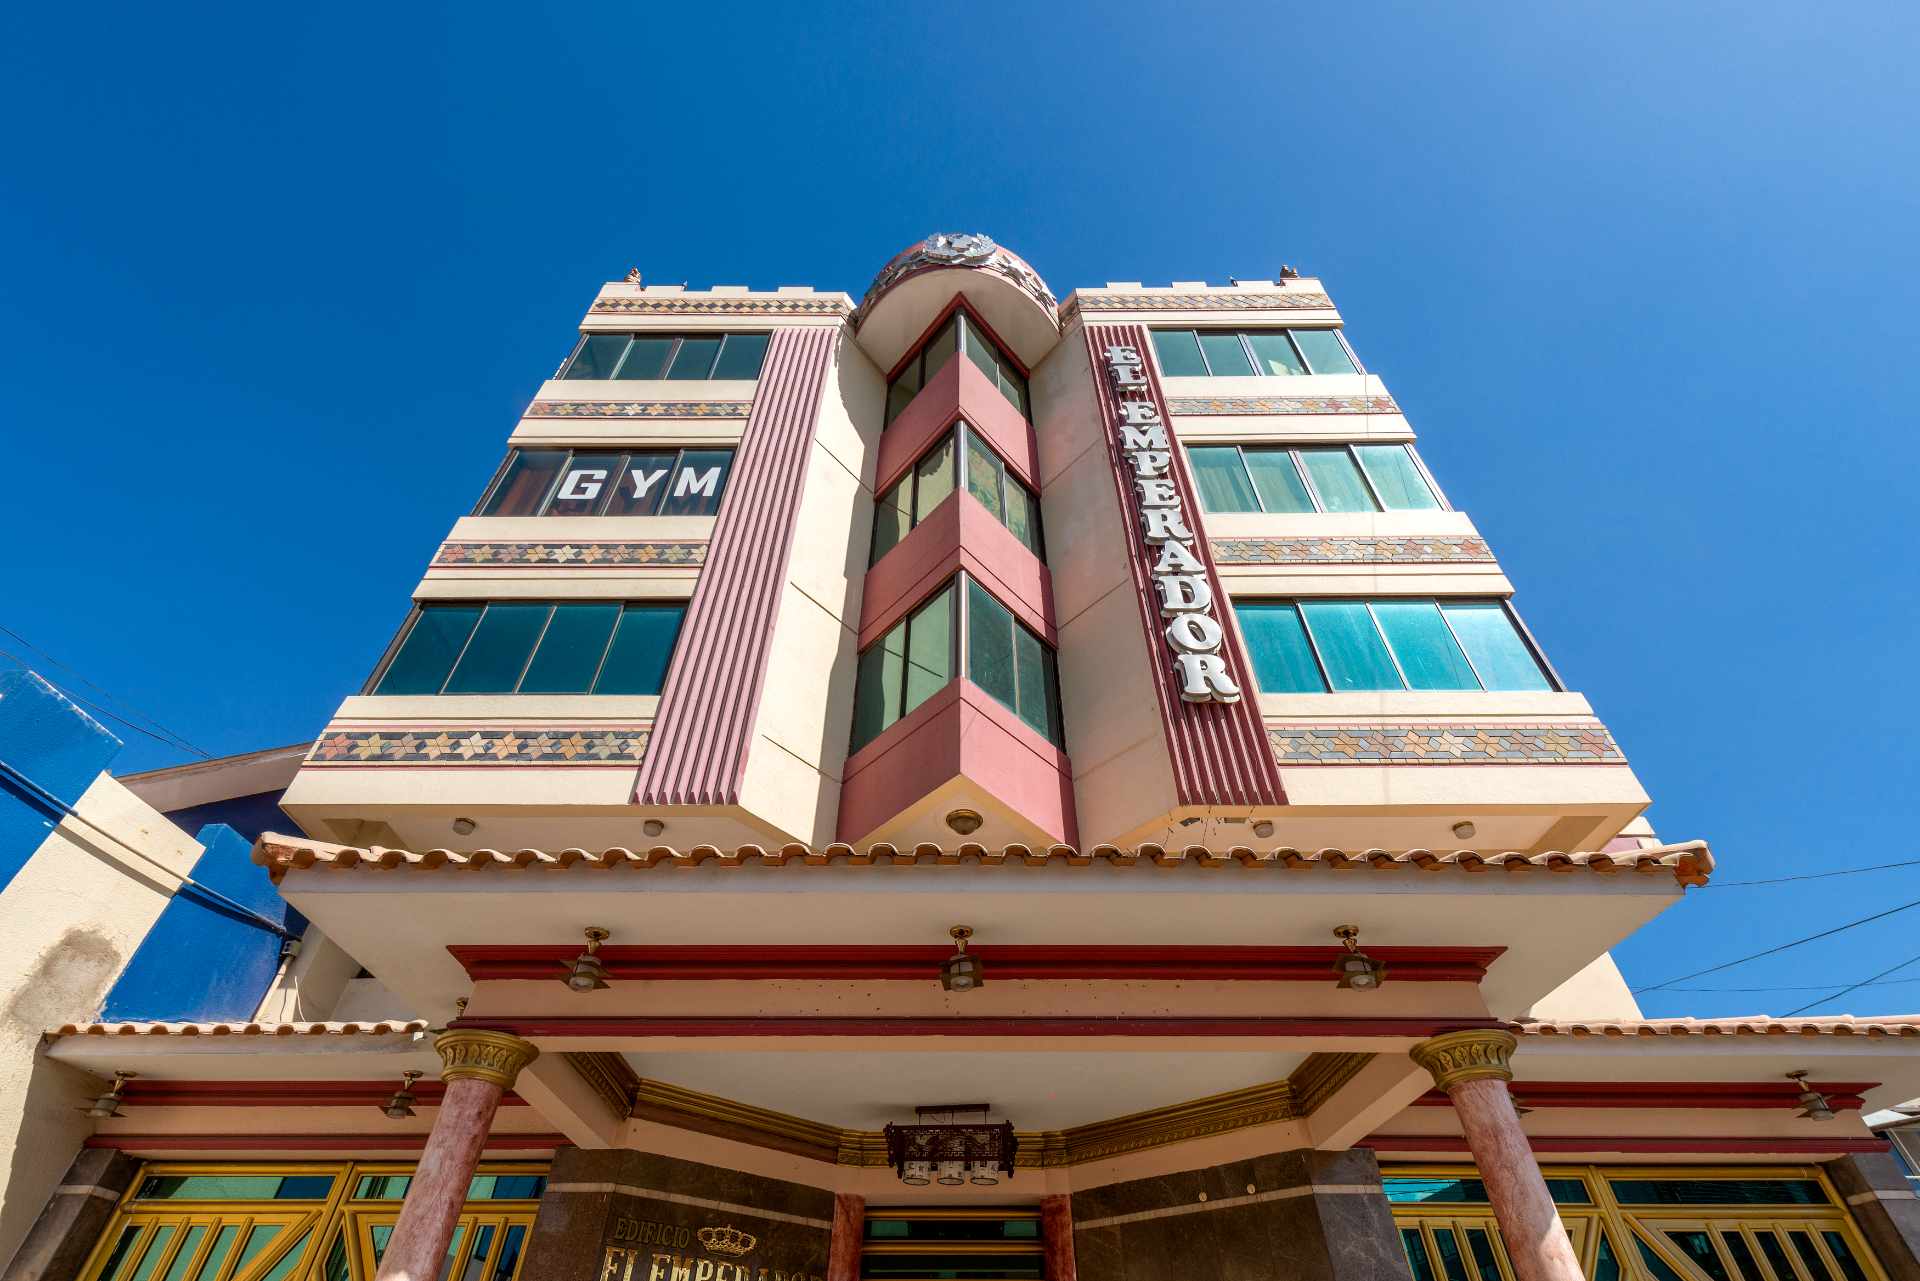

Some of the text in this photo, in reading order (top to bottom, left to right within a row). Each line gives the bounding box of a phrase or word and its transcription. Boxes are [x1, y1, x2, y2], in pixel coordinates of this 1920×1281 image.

[557, 466, 721, 500] GYM
[1104, 345, 1240, 704] EL EMPERADOR
[613, 1216, 691, 1249] EDIFICIO
